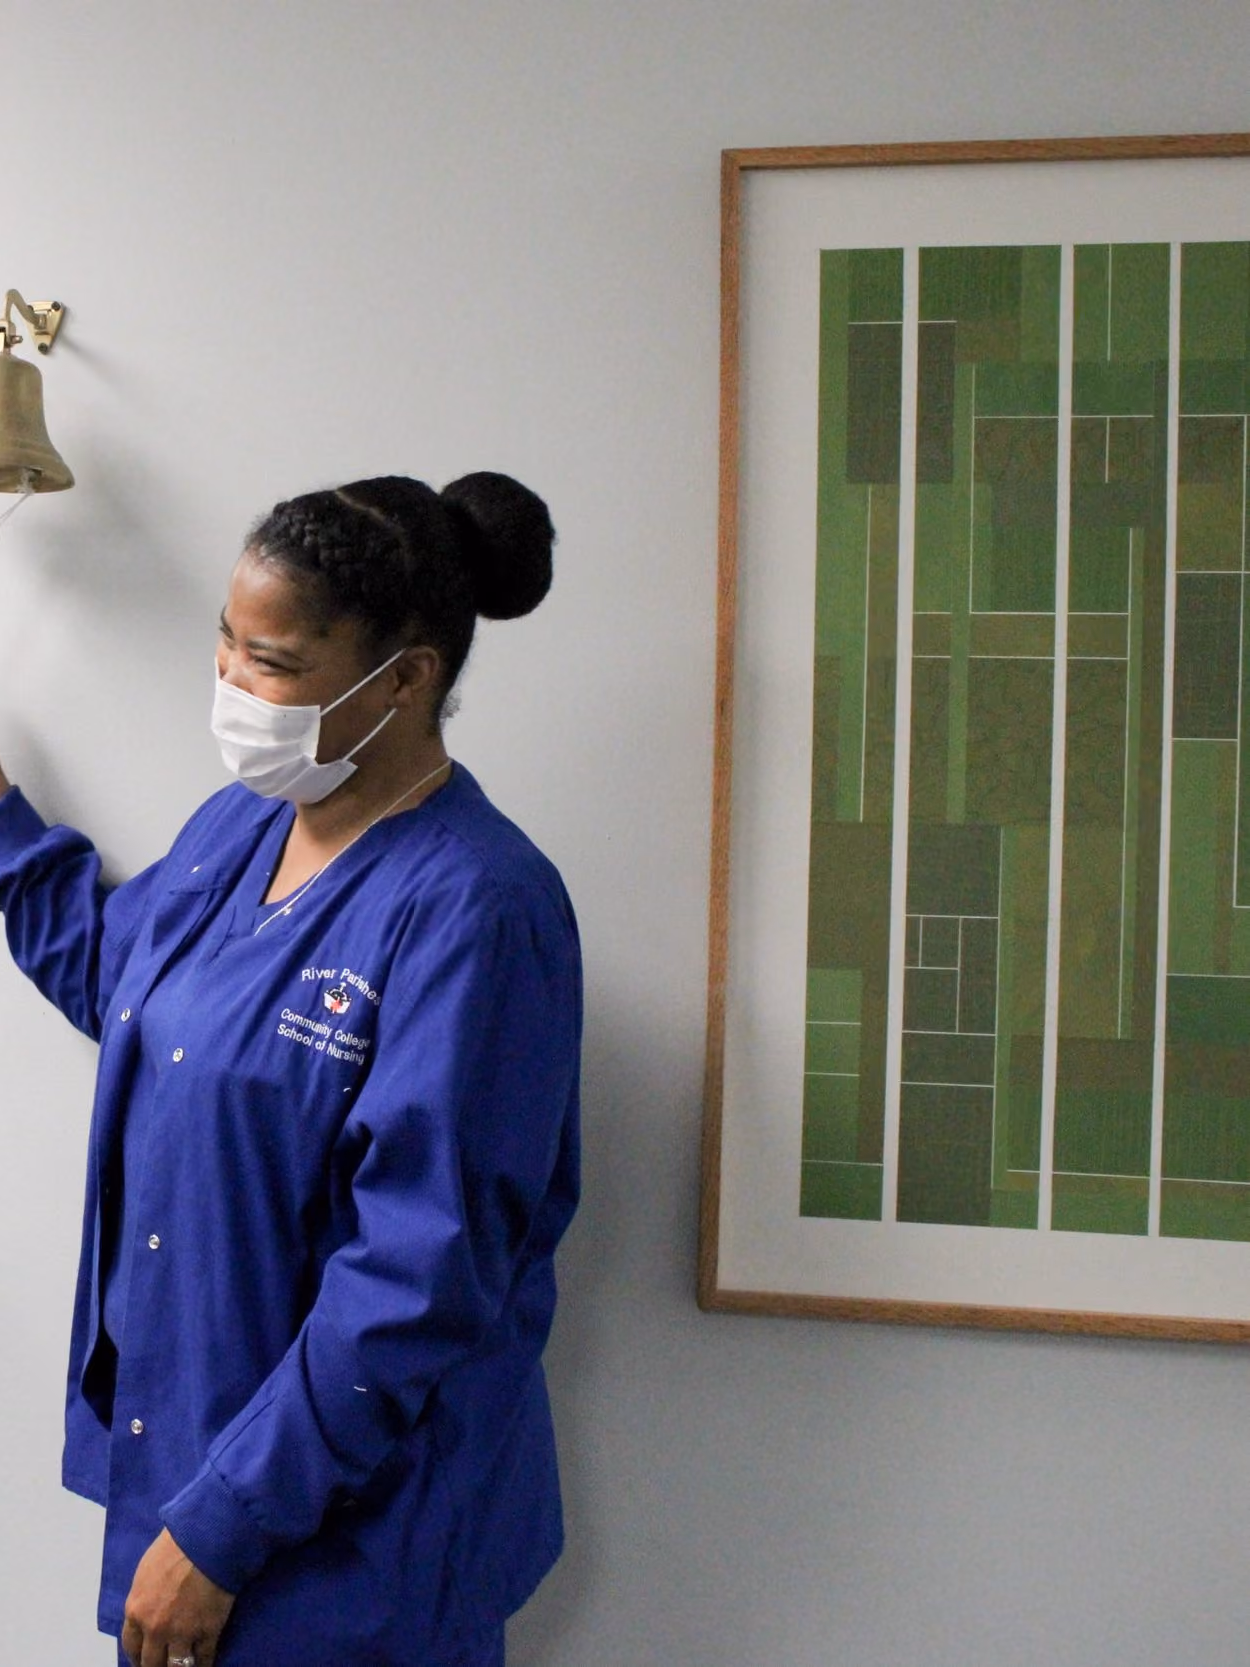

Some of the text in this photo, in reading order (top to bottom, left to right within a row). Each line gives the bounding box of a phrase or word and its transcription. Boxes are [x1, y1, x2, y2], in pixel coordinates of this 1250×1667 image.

[302, 967, 336, 981] River
[281, 1008, 331, 1038] Community
[277, 1024, 365, 1066] School of Nursing
